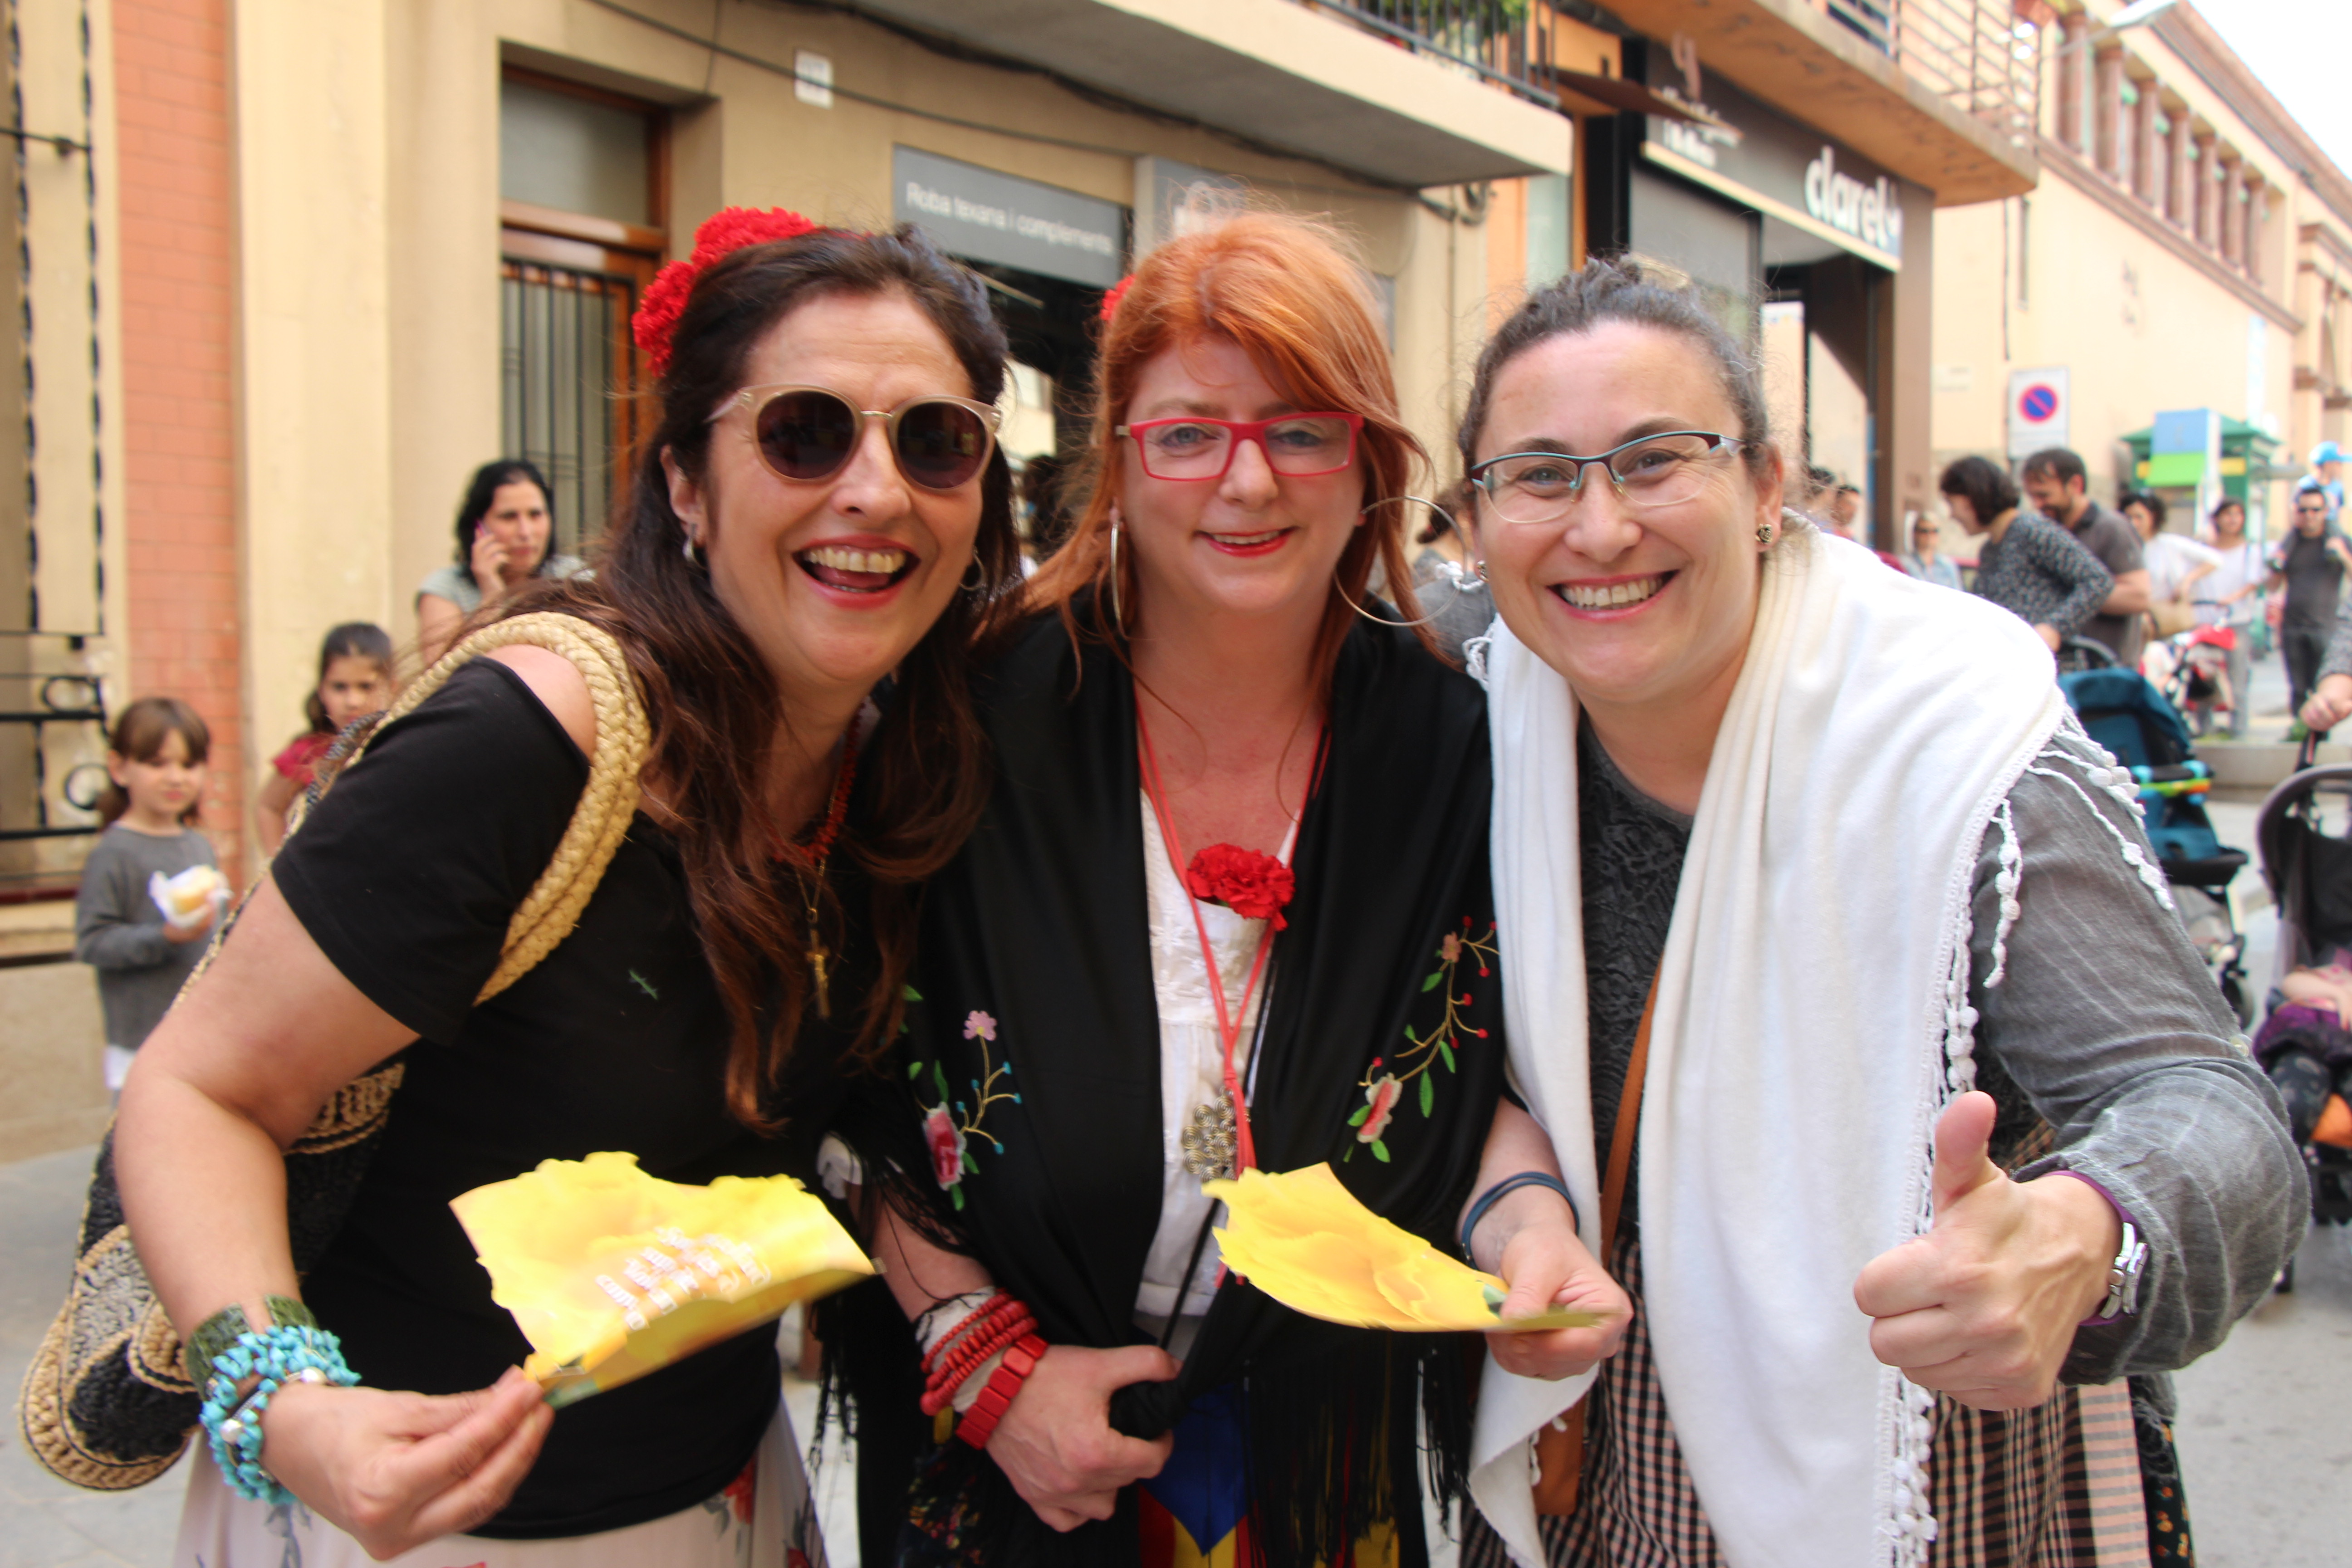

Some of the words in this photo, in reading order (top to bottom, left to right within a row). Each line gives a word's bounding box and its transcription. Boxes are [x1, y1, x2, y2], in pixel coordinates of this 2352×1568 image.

[906, 182, 951, 218] Roba
[954, 196, 1006, 231] texana
[1008, 206, 1016, 230] i
[1018, 214, 1115, 257] complements
